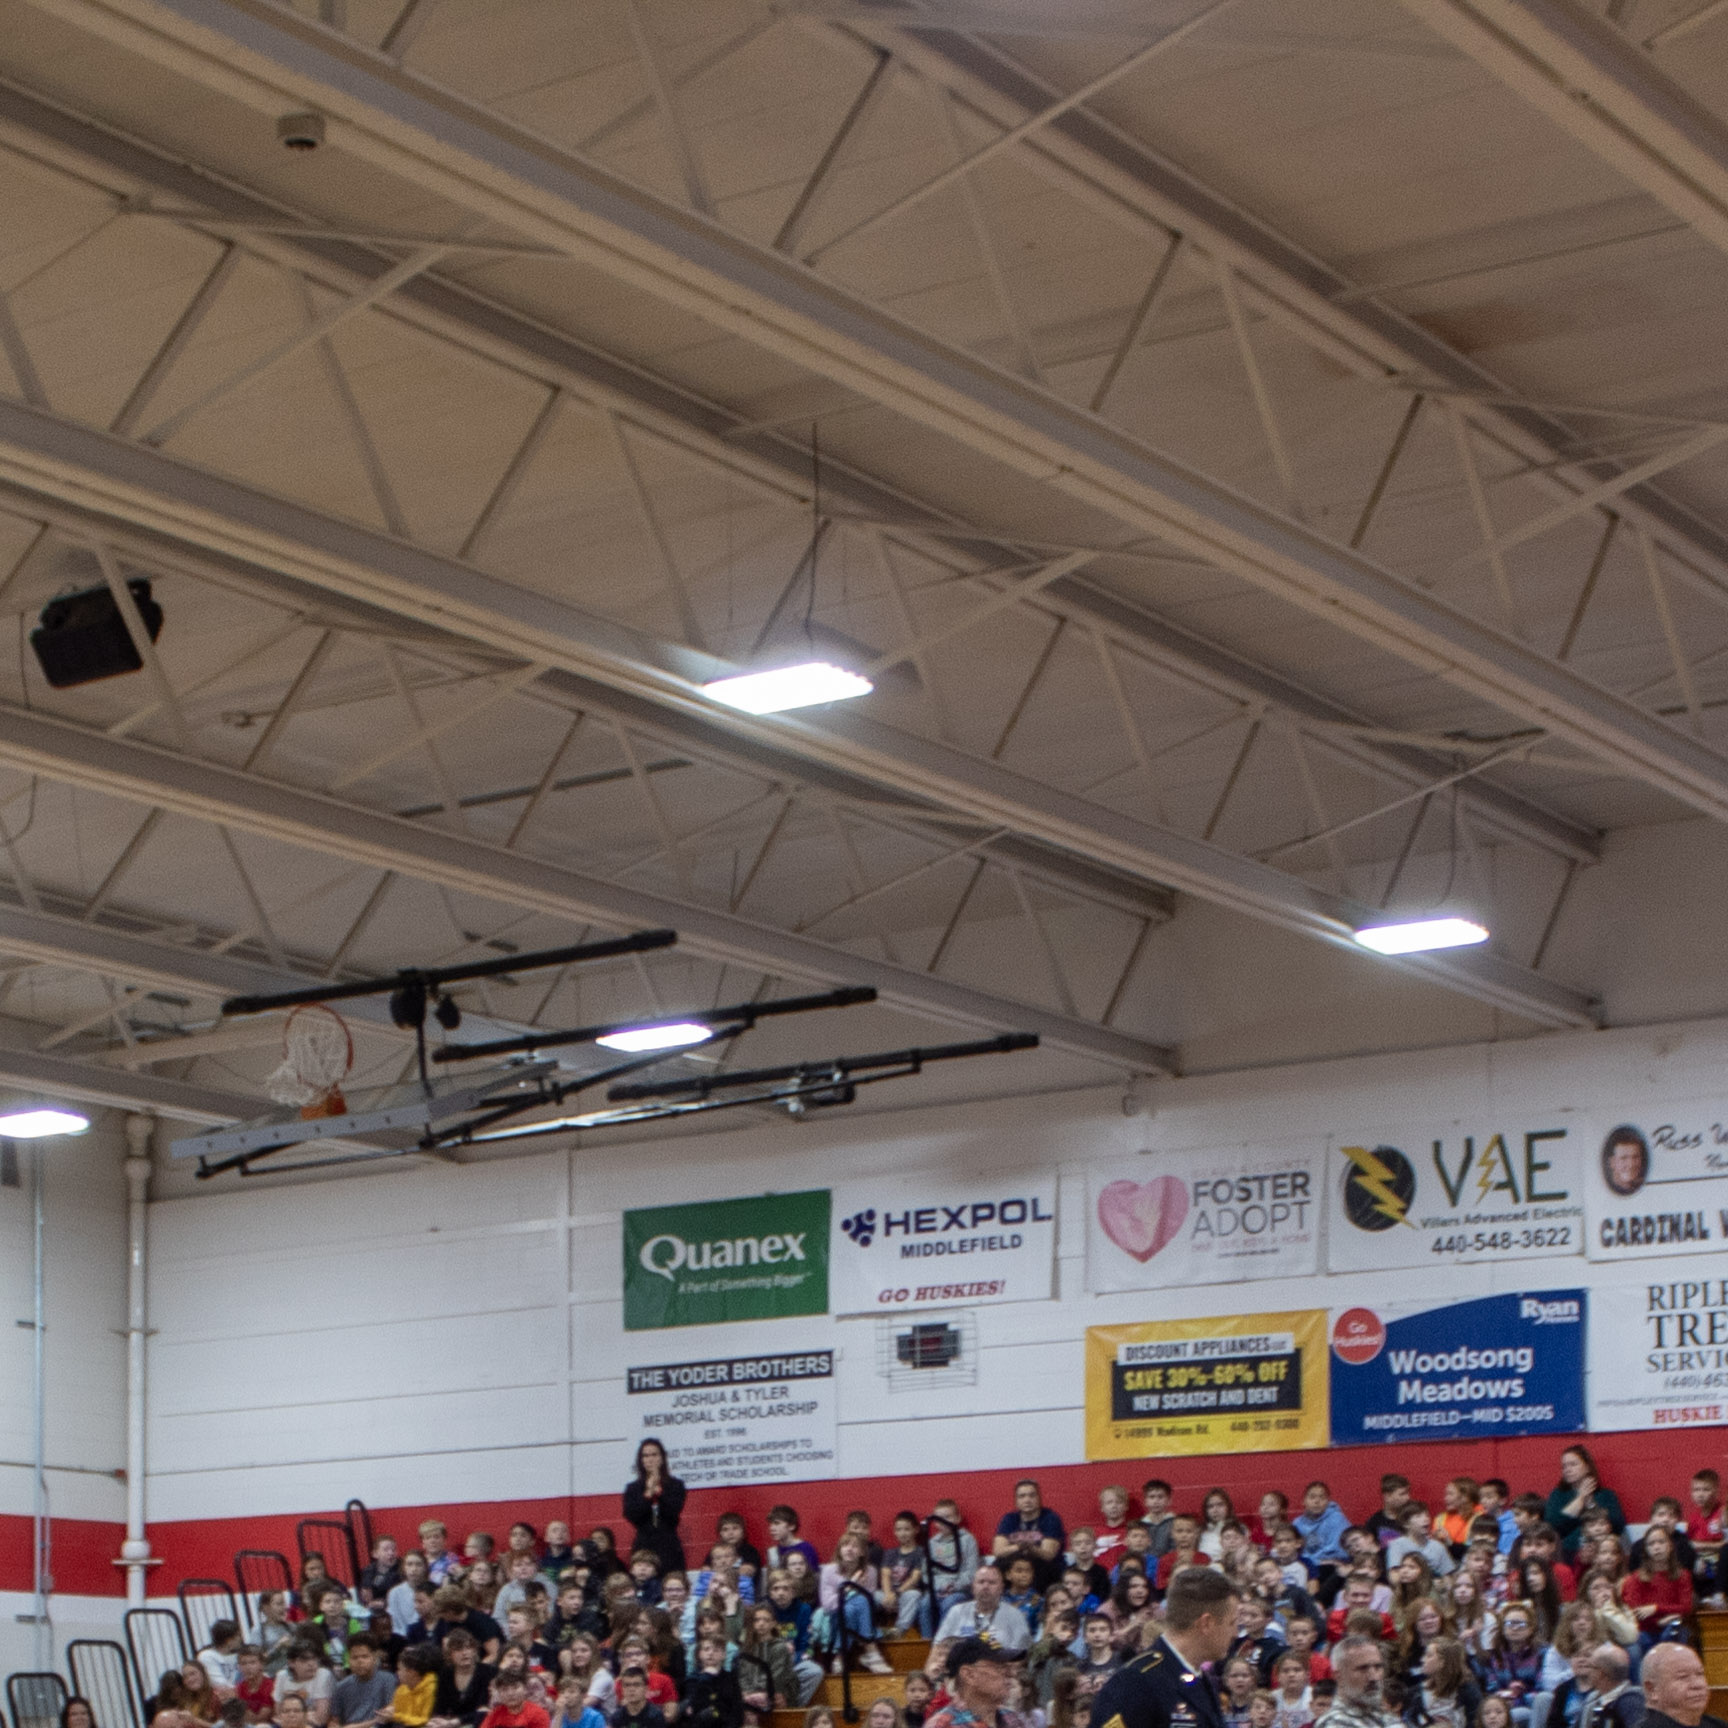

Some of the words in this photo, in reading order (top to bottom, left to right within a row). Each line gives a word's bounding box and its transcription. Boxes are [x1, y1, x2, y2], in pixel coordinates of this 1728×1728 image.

[1432, 1128, 1568, 1207] VAE
[1193, 1171, 1310, 1206] FOSTER
[884, 1197, 1053, 1237] HEXPOL
[1191, 1200, 1311, 1240] ADOPT
[1600, 1211, 1709, 1247] CARDINAL
[640, 1233, 806, 1281] Quanex
[901, 1234, 1022, 1259] MIDDLEFIELD
[878, 1287, 910, 1303] GO
[914, 1280, 1006, 1301] HUSKIES!
[1521, 1299, 1580, 1325] Ryan
[1126, 1342, 1187, 1361] DISCOUNT
[1193, 1337, 1270, 1356] APPLIANCES
[1388, 1346, 1533, 1375] Woodsong
[630, 1371, 665, 1390] THE
[668, 1365, 729, 1386] YODER
[732, 1356, 831, 1380] BROTHERS
[1124, 1368, 1163, 1391] SAVE
[1258, 1360, 1289, 1382] OFF
[673, 1391, 726, 1408] JOSHUA
[731, 1390, 741, 1403] &
[745, 1386, 789, 1403] TYLER
[1132, 1394, 1160, 1411] NEW
[1162, 1391, 1218, 1411] SCRATCH
[1218, 1389, 1244, 1406] AND
[1247, 1387, 1279, 1404] DENT
[1398, 1377, 1524, 1405] Meadows
[644, 1409, 715, 1428] MEMORIAL
[720, 1402, 819, 1421] SCHOLARSHIP
[1653, 1405, 1721, 1424] HUSKIE
